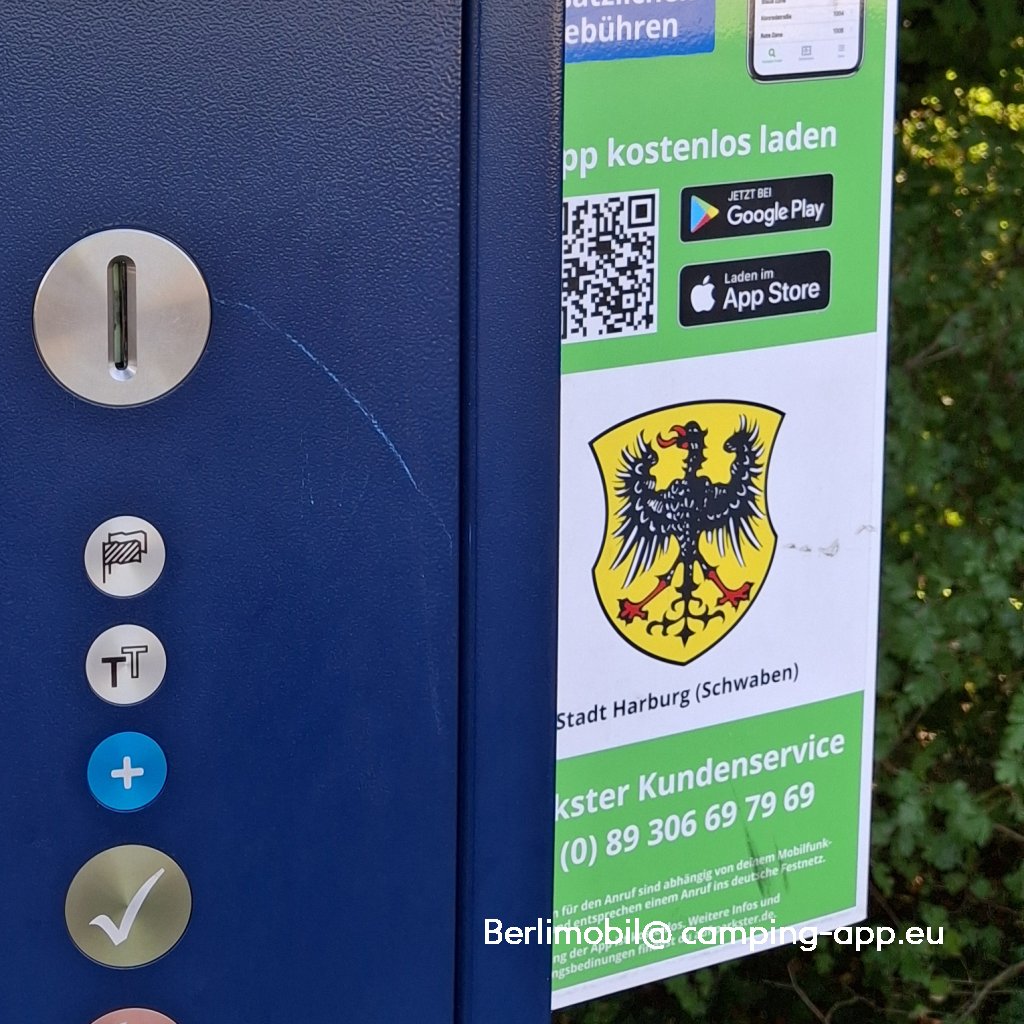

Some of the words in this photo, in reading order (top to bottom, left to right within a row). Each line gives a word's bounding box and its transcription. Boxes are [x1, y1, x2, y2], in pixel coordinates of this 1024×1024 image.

[565, 15, 678, 44] ebühren
[608, 128, 751, 167] kostenlos
[760, 122, 837, 153] laden
[727, 201, 789, 227] Google
[791, 198, 825, 222] Play
[728, 189, 756, 202] JETZT
[758, 187, 772, 199] BEI
[723, 286, 764, 312] App
[768, 281, 821, 304] Store
[725, 270, 758, 284] Laden
[761, 268, 774, 279] im
[557, 705, 607, 730] Stadt
[613, 687, 690, 718] Harburg
[695, 662, 799, 703] (Schwaben)
[639, 733, 845, 801] Kundenservice
[560, 835, 597, 872] (0)
[606, 825, 640, 856] 89
[647, 809, 697, 846] 306
[704, 800, 738, 831] 69
[744, 791, 776, 822] 79
[783, 781, 816, 812] 69
[562, 905, 578, 916] für
[581, 899, 602, 911] den
[604, 887, 636, 906] Anruf
[638, 881, 661, 897] sind
[663, 868, 713, 890] abhängig
[715, 864, 734, 876] von
[736, 853, 775, 871] deinem
[777, 838, 832, 860] Mobilfunk-
[569, 946, 588, 959] der
[688, 908, 733, 926] Weitere
[732, 901, 758, 915] Infos
[760, 893, 781, 907] und
[574, 903, 642, 928] entsprechen
[645, 893, 678, 910] einem
[681, 882, 711, 900] Anruf
[713, 879, 729, 892] ins
